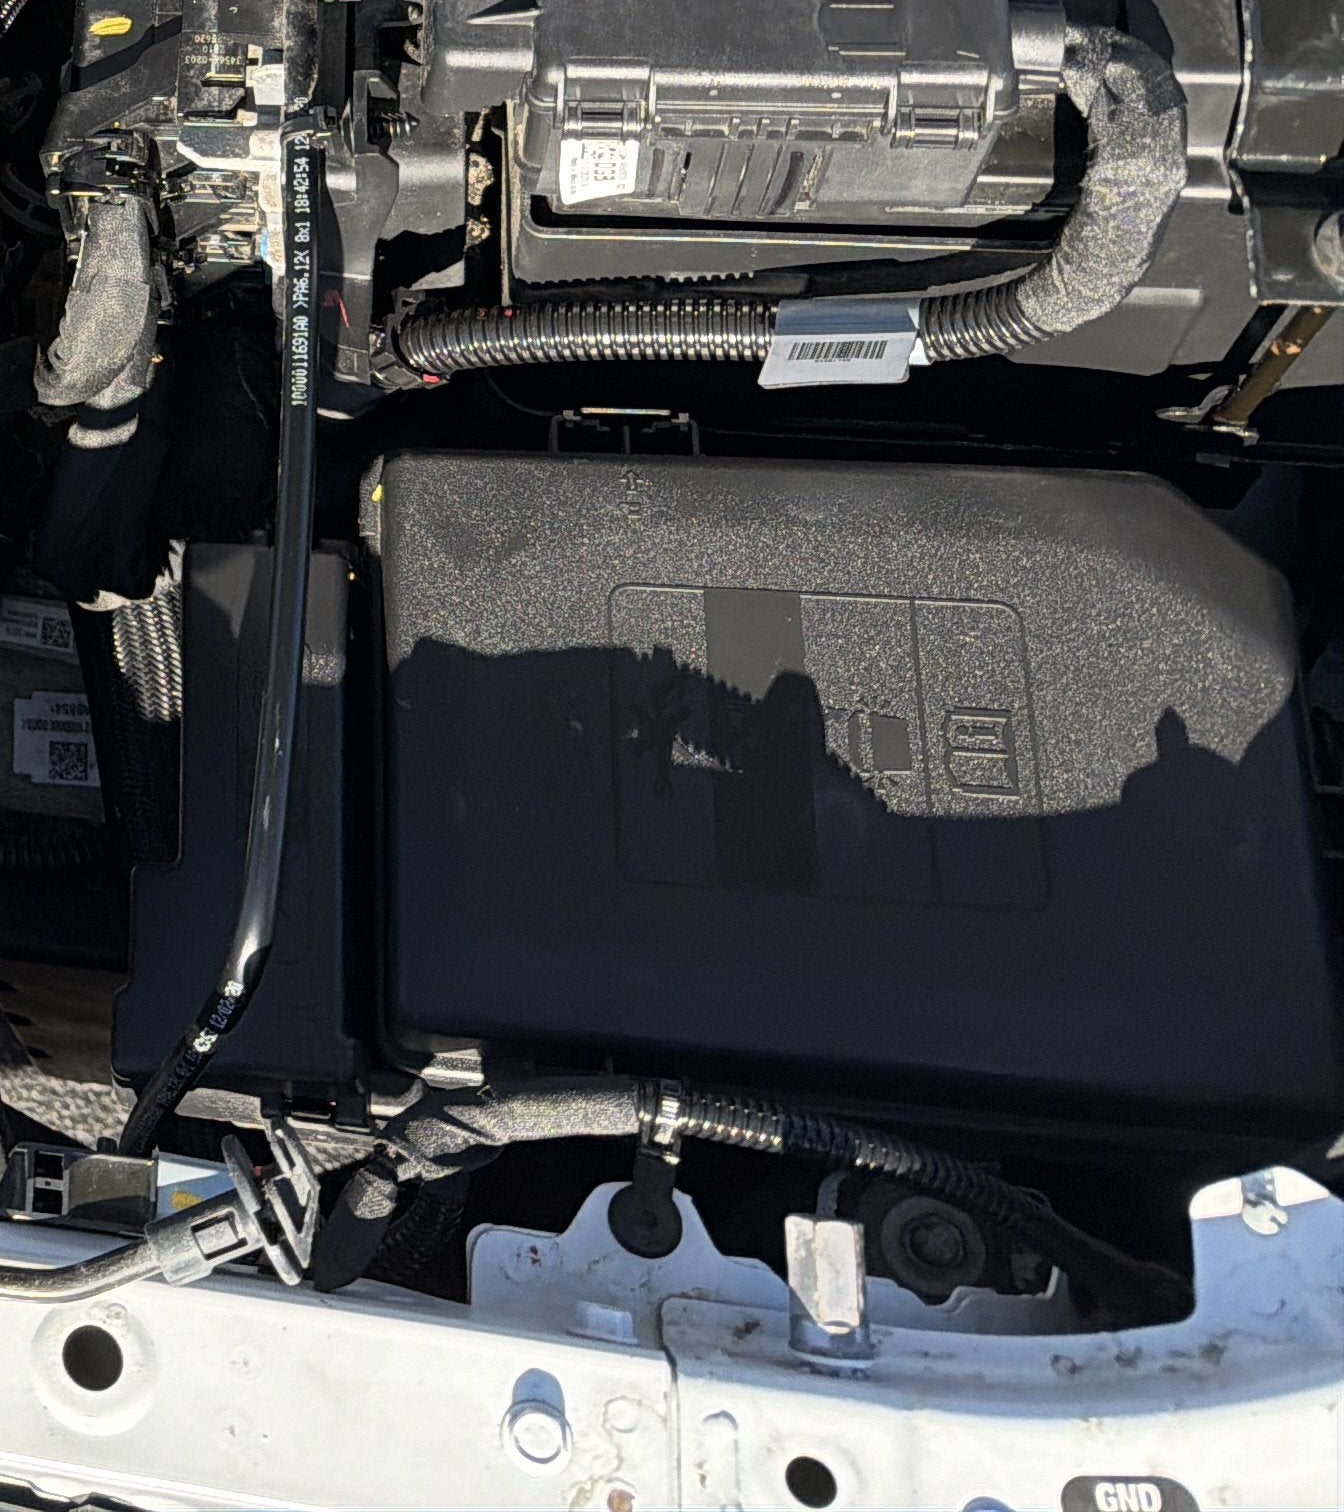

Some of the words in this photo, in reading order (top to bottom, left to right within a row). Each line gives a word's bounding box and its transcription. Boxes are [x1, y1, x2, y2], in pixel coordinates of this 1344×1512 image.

[294, 157, 310, 214] 18:42:54
[295, 221, 310, 243] 8x1
[292, 316, 309, 406] 1000011691A0
[1095, 1482, 1162, 1512] GND
